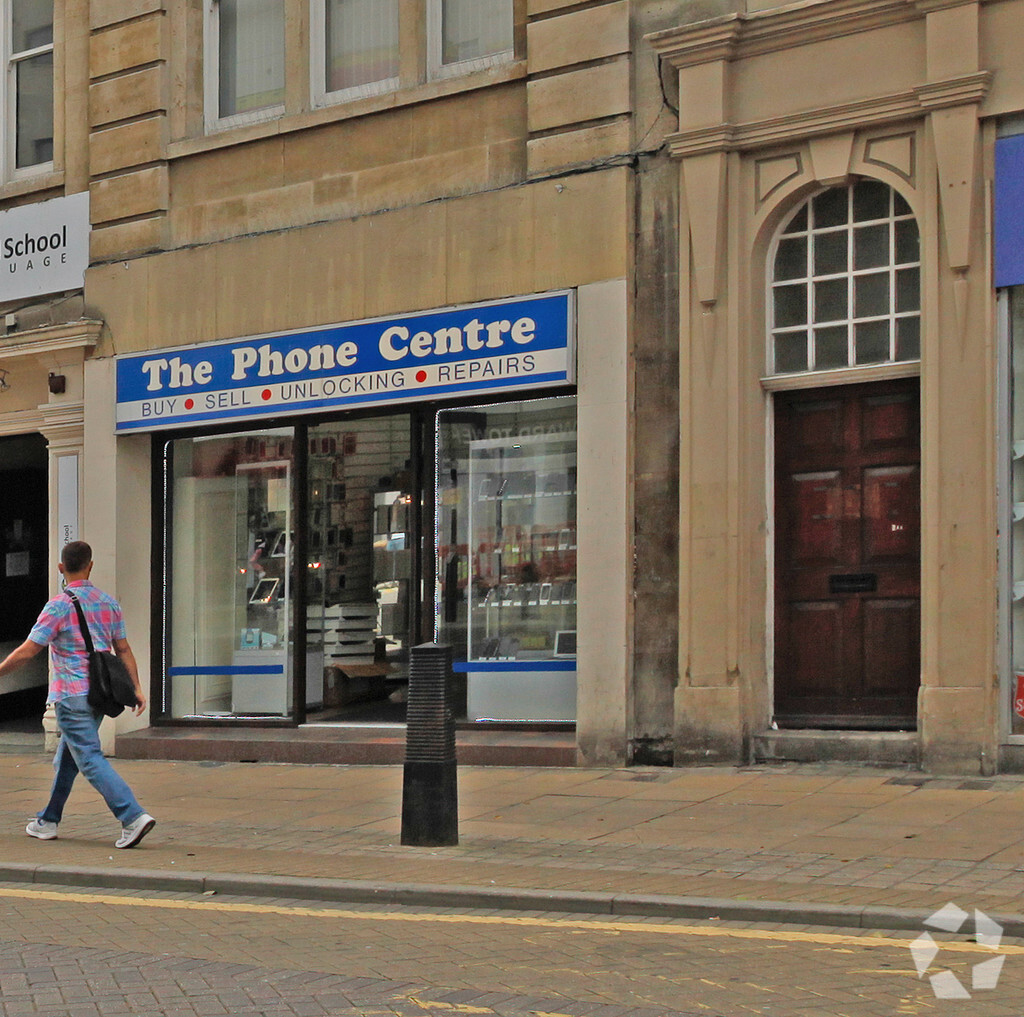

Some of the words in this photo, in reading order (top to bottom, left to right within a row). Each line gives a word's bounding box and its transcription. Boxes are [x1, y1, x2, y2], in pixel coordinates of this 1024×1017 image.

[141, 356, 213, 391] The
[230, 341, 359, 381] Phone
[378, 316, 536, 361] Centre
[141, 399, 177, 417] BUY
[205, 390, 251, 409] SELL
[280, 371, 406, 401] UNLOCKING
[438, 354, 536, 382] REPAIRS
